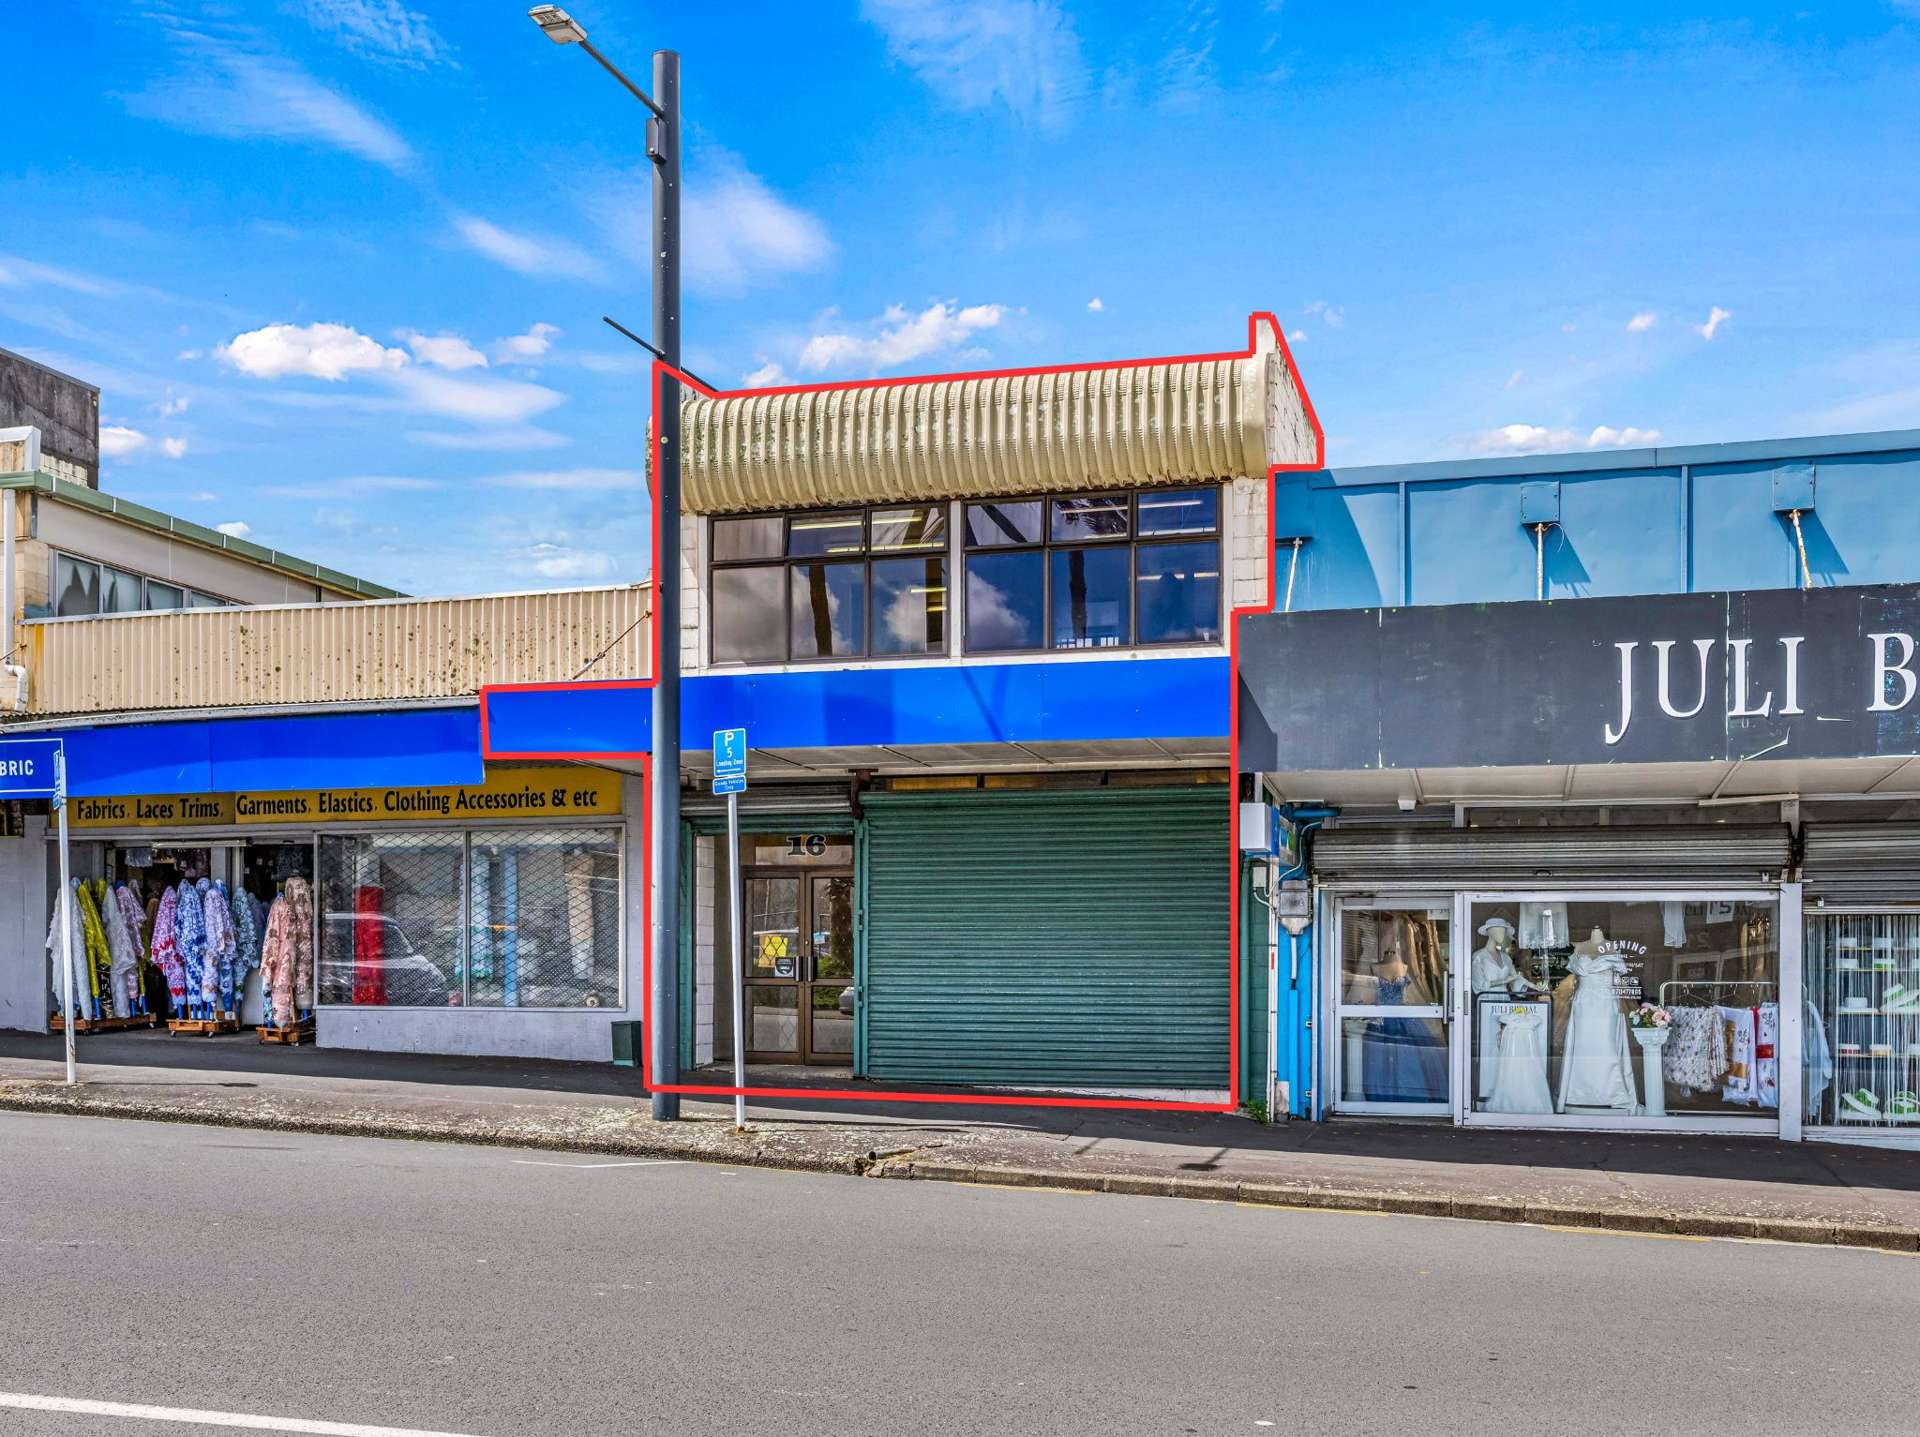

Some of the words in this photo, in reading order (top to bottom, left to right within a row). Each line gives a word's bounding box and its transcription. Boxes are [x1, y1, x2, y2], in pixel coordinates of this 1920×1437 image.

[1605, 637, 1805, 745] JULI
[1866, 633, 1917, 711] B
[724, 732, 735, 747] P
[727, 747, 733, 759] 5
[136, 799, 174, 819] Laces
[384, 790, 450, 814] Clothing
[455, 785, 546, 810] Accessories
[551, 789, 567, 807] &
[573, 789, 598, 807] etc
[787, 834, 827, 856] 16
[1598, 940, 1647, 955] OPENING
